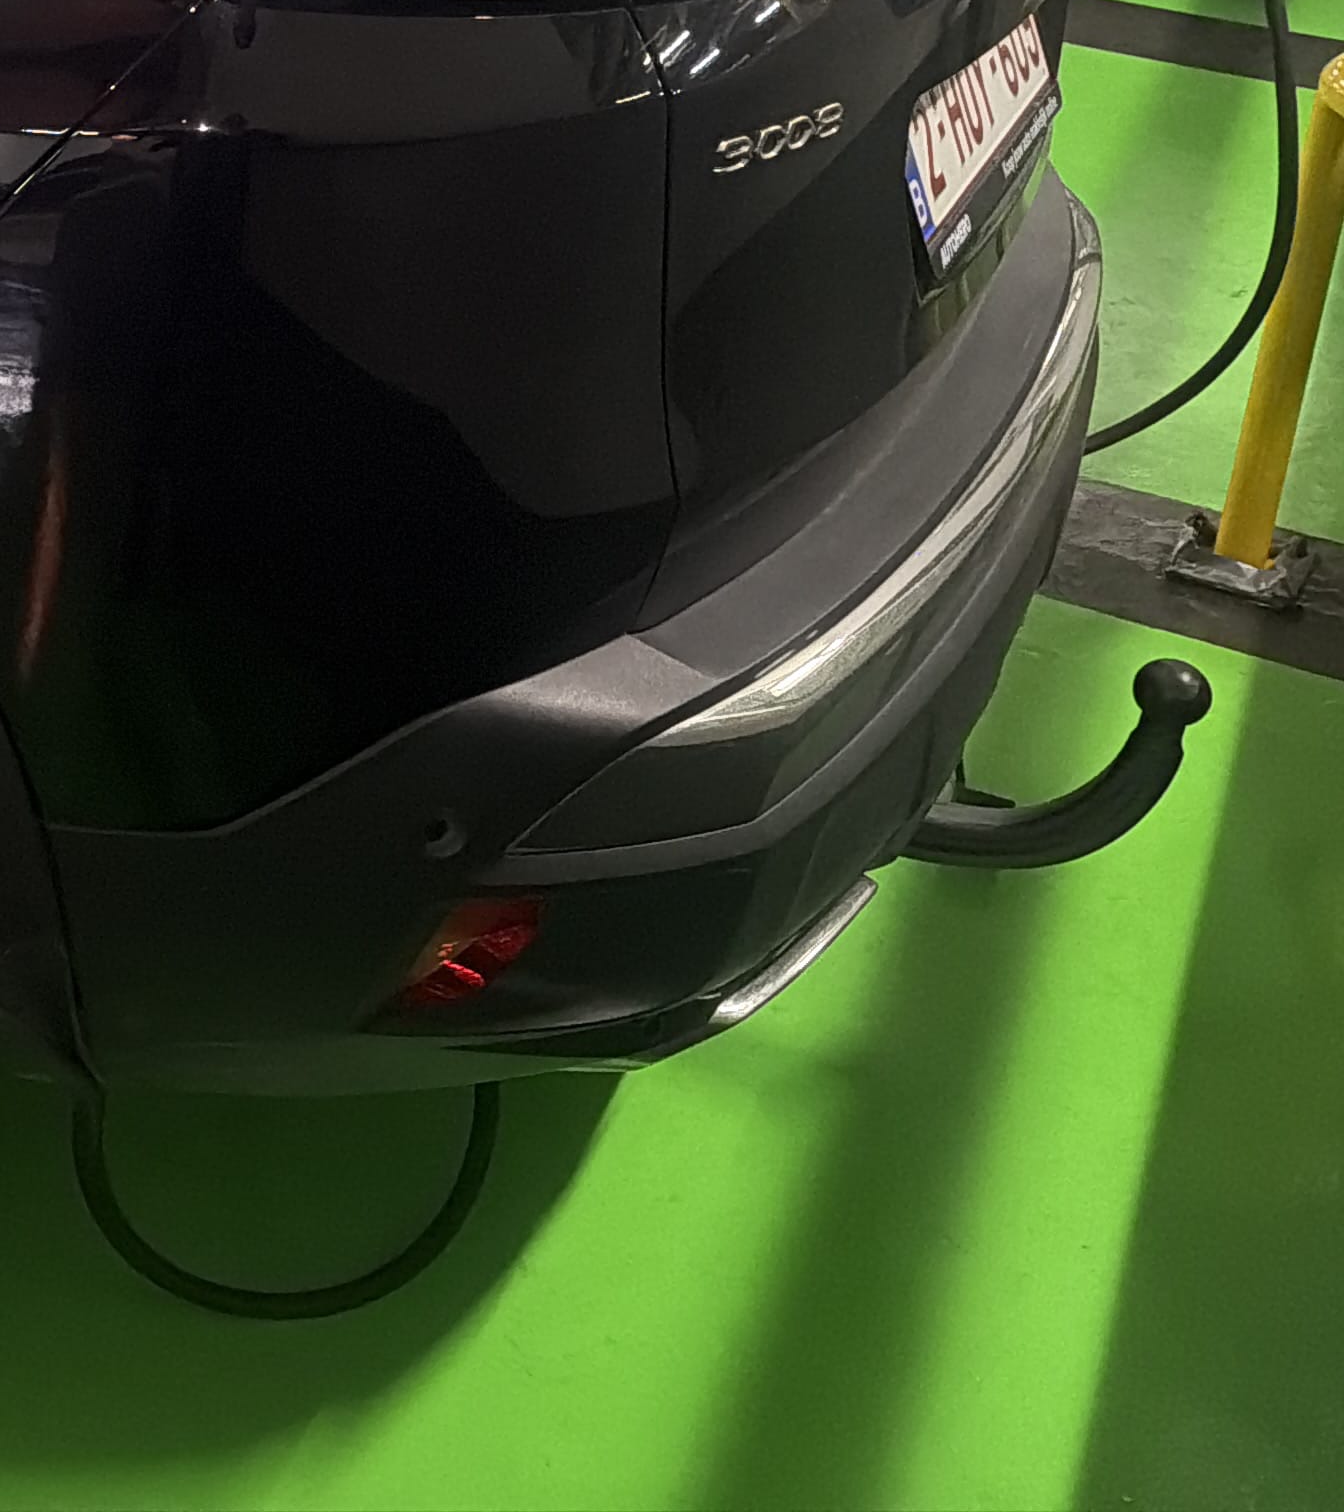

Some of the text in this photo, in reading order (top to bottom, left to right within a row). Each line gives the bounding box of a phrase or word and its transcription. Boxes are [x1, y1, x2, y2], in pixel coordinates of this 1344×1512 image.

[712, 102, 844, 172] 3008
[909, 178, 929, 228] B
[940, 213, 973, 272] AUTOHERO
